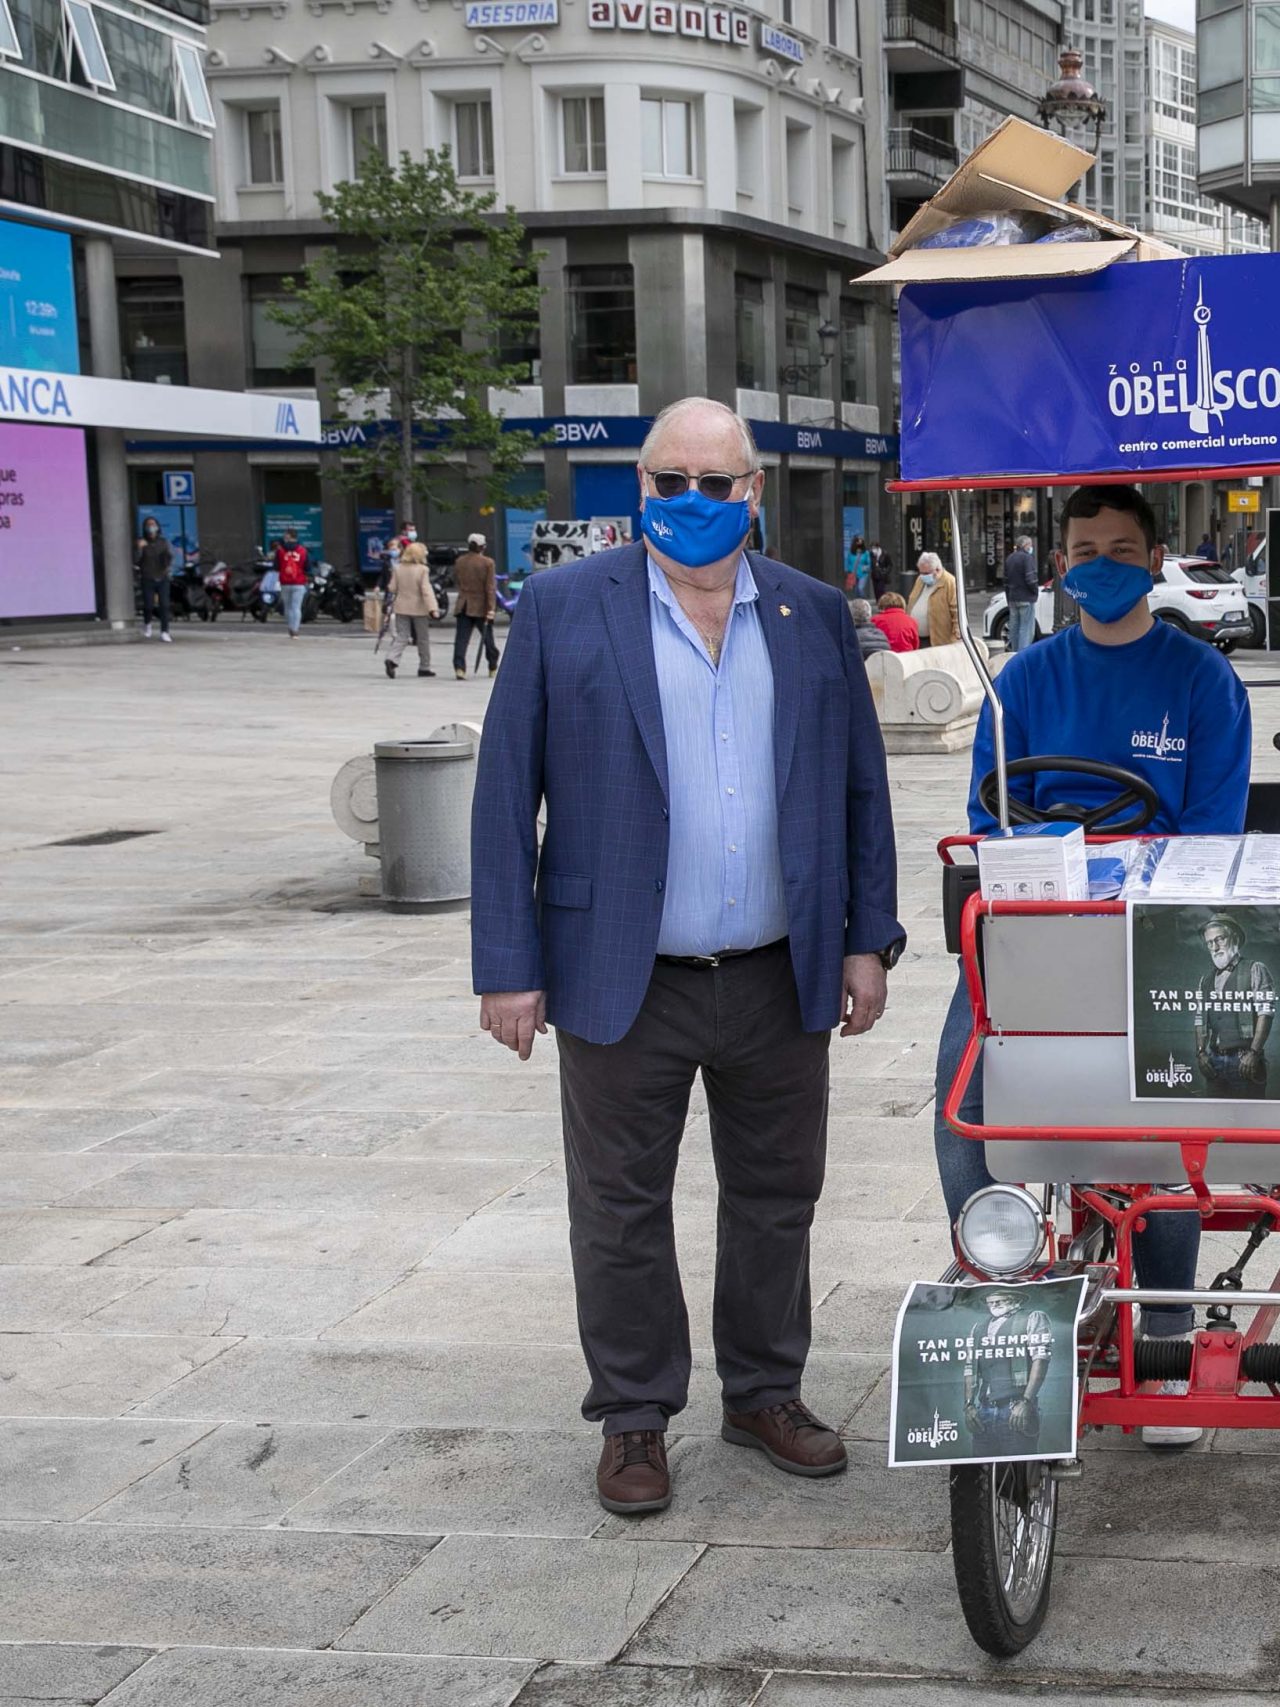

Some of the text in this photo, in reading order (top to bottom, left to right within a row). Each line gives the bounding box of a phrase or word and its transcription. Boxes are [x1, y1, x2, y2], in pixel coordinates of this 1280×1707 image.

[468, 2, 556, 24] ASESORIA
[591, 1, 749, 39] avante
[764, 26, 804, 60] LABORAL
[1109, 358, 1187, 375] zona
[554, 421, 608, 441] BBVA
[797, 431, 822, 448] BBVA
[865, 438, 888, 453] BBVA
[1119, 434, 1278, 452] centro comercial urbano
[170, 475, 187, 498] P
[1131, 734, 1186, 751] OBELISCO
[1150, 990, 1280, 1001] TAN DE SIEMPRE.
[1153, 1002, 1276, 1012] TAN DIFERENTE.
[917, 1333, 1056, 1350] TAN DE SIEMPRE.
[920, 1346, 1052, 1363] TAN DIFERENTE.
